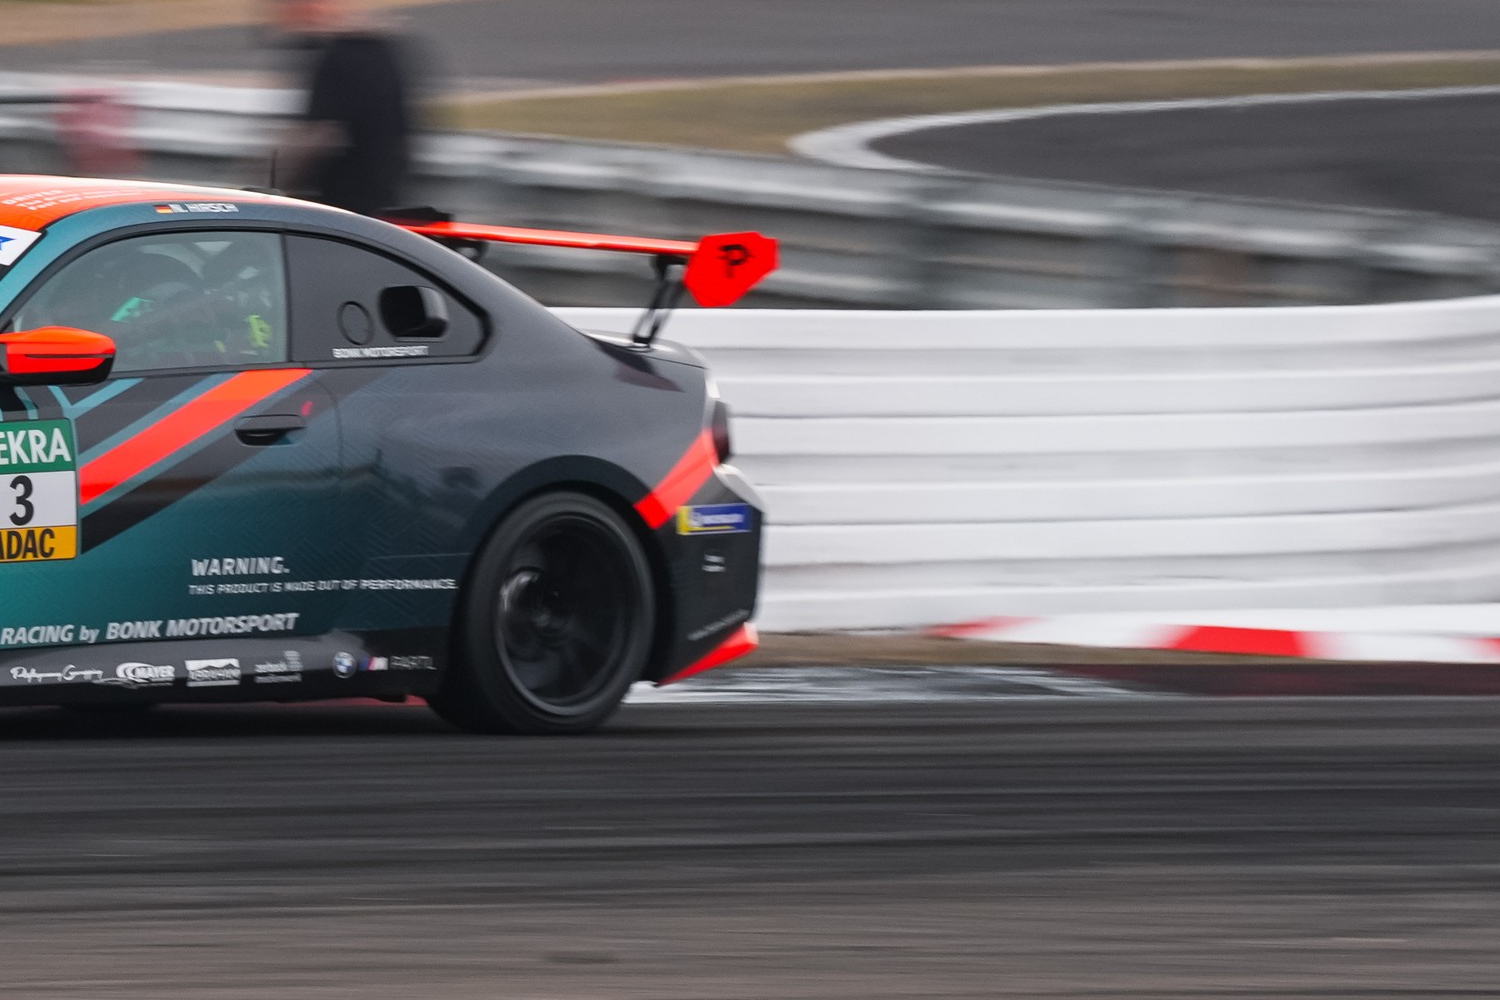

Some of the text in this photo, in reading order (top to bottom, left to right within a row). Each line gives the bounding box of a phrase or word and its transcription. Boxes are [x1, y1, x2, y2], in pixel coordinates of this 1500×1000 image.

[9, 475, 34, 526] 3
[191, 556, 290, 576] WARNING.
[189, 584, 215, 595] THIS
[217, 583, 268, 594] PRODUCT
[270, 582, 282, 592] IS
[284, 581, 315, 592] MADE
[317, 580, 340, 591] OUT
[341, 579, 357, 590] OF
[0, 625, 75, 645] RACING
[79, 625, 100, 643] by
[105, 620, 162, 640] BONK
[165, 612, 300, 637] MOTORSPORT
